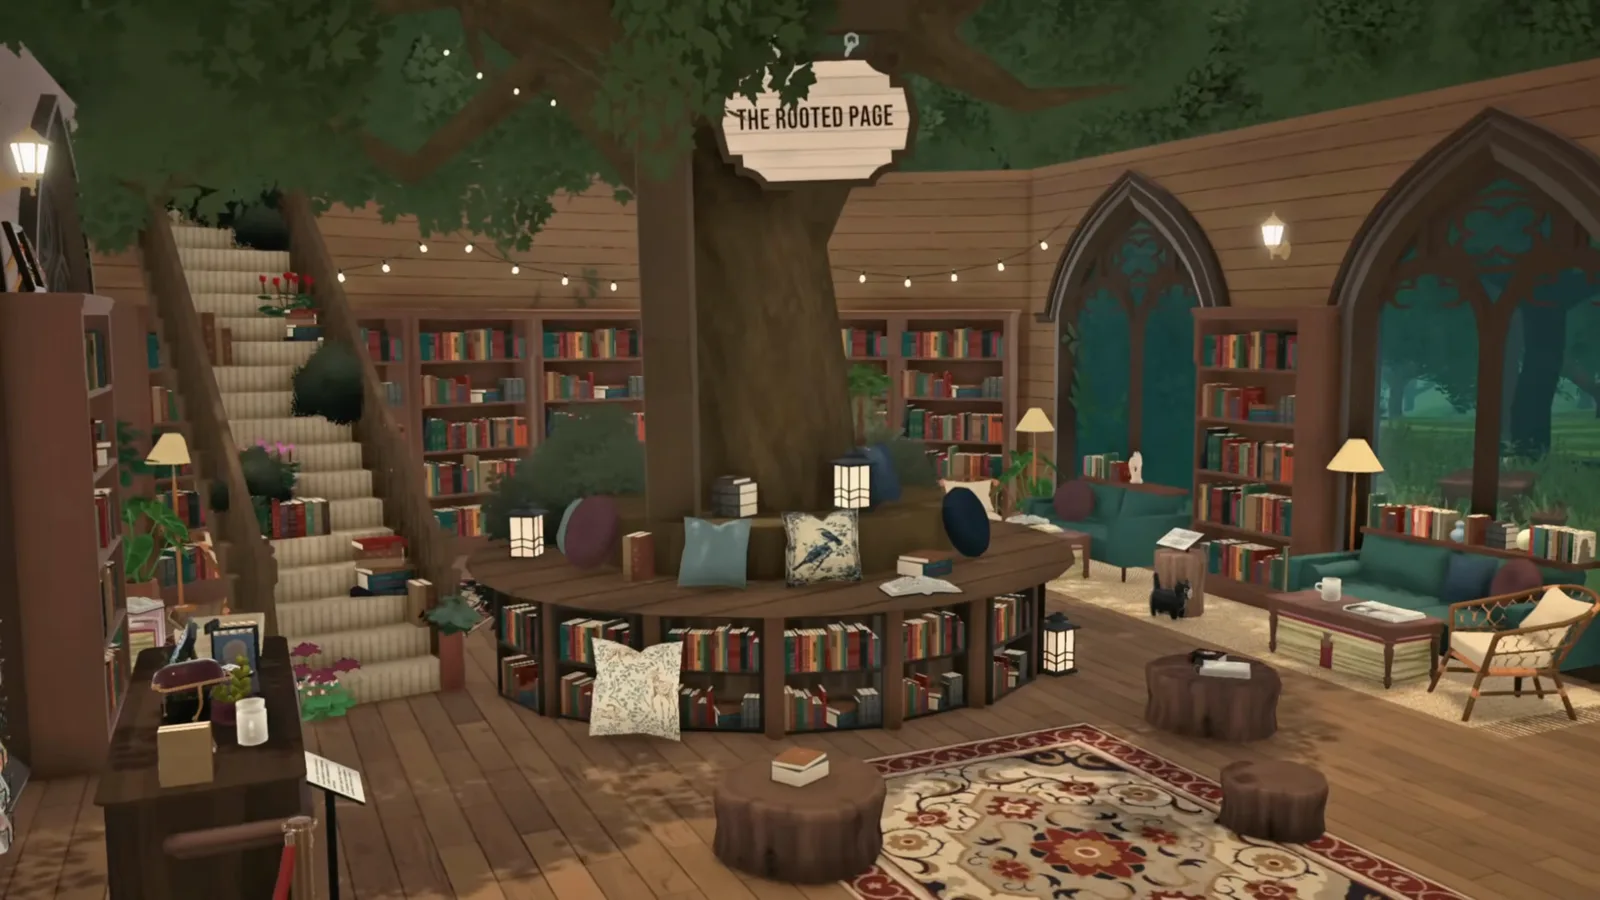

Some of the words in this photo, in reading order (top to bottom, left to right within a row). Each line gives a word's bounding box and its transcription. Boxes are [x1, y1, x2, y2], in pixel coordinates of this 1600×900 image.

[737, 107, 770, 130] THE
[776, 106, 843, 129] ROOTED
[849, 104, 894, 127] PAGE
